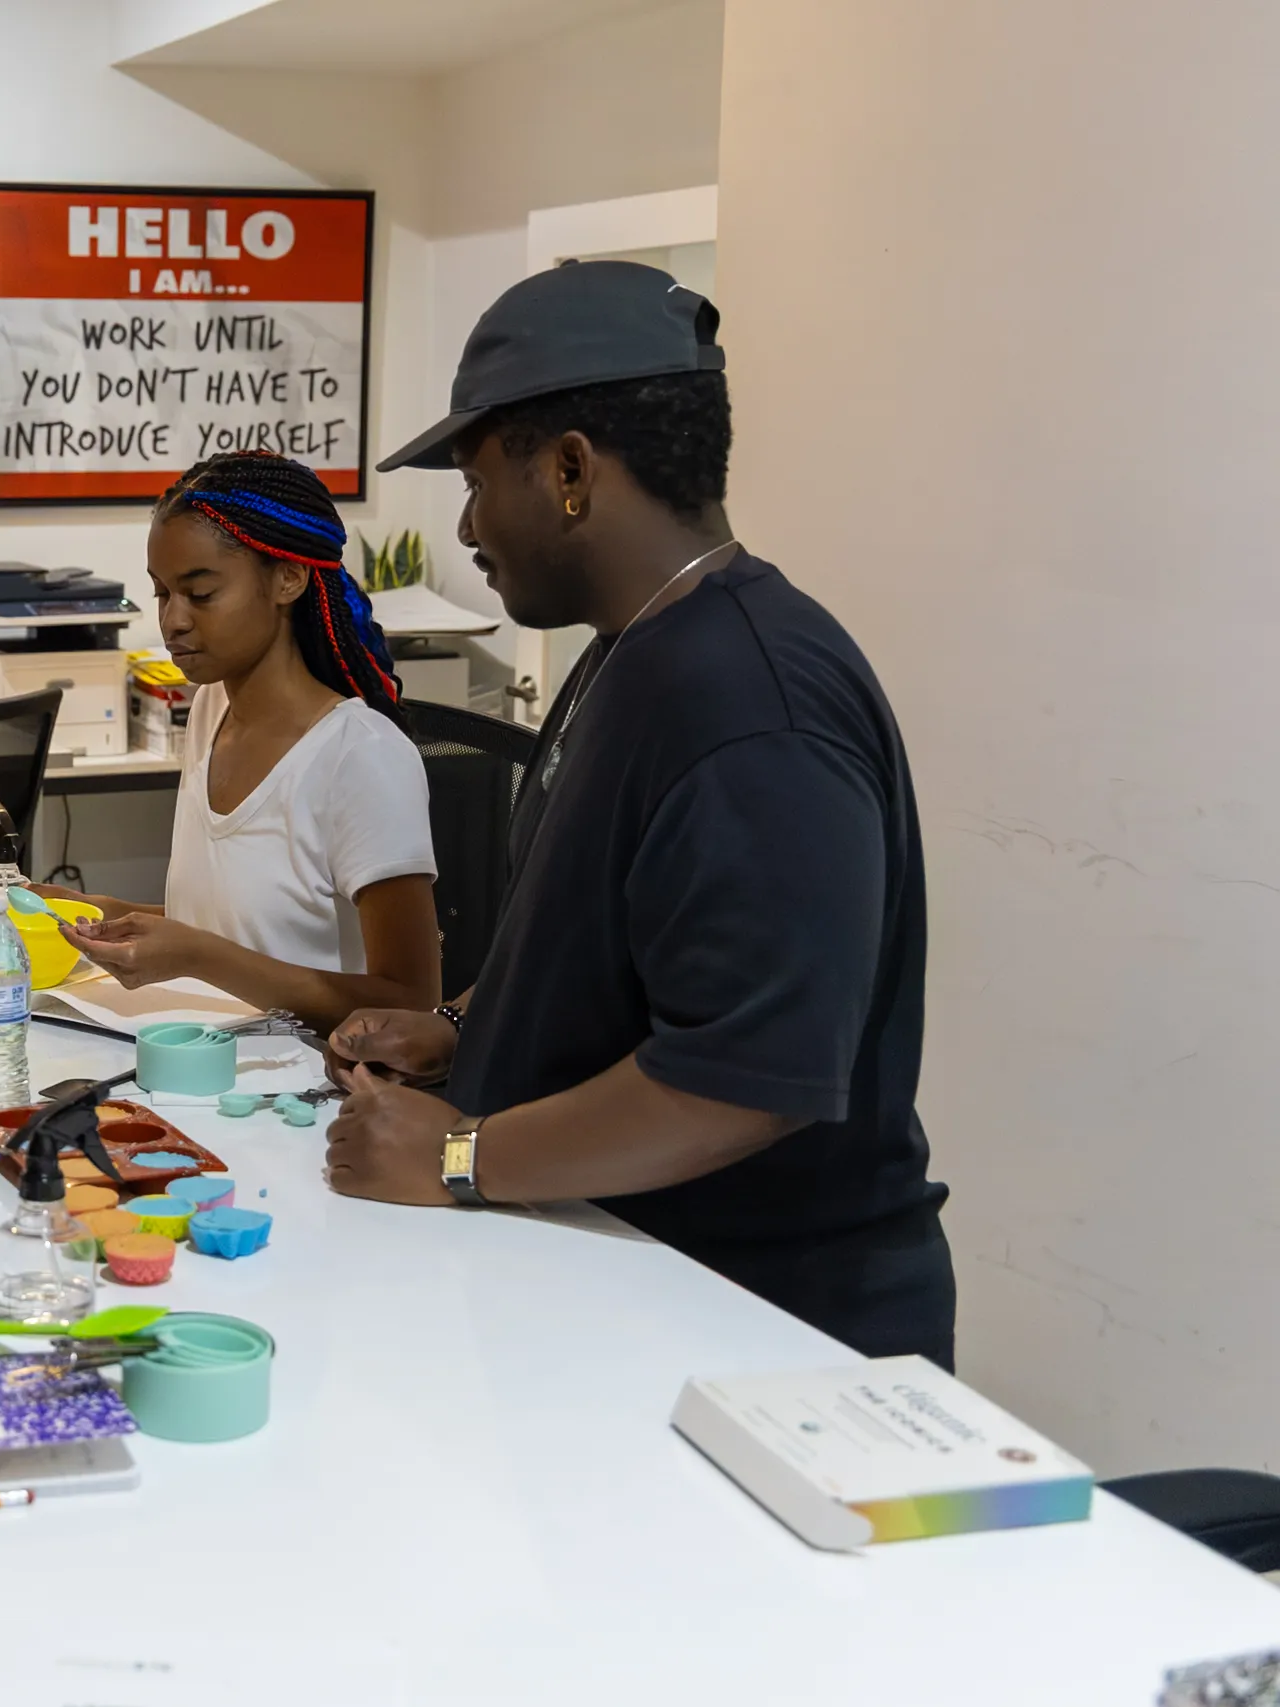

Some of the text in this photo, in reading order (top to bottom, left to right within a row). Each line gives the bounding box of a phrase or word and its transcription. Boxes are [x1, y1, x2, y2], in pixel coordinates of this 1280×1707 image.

[68, 206, 295, 260] HELLO
[129, 269, 250, 294] I AM...
[82, 315, 284, 353] WORK UNTIL
[22, 368, 339, 406] YOU DON'T HAVE TO
[4, 419, 345, 461] INTRODUCE YOURSELF
